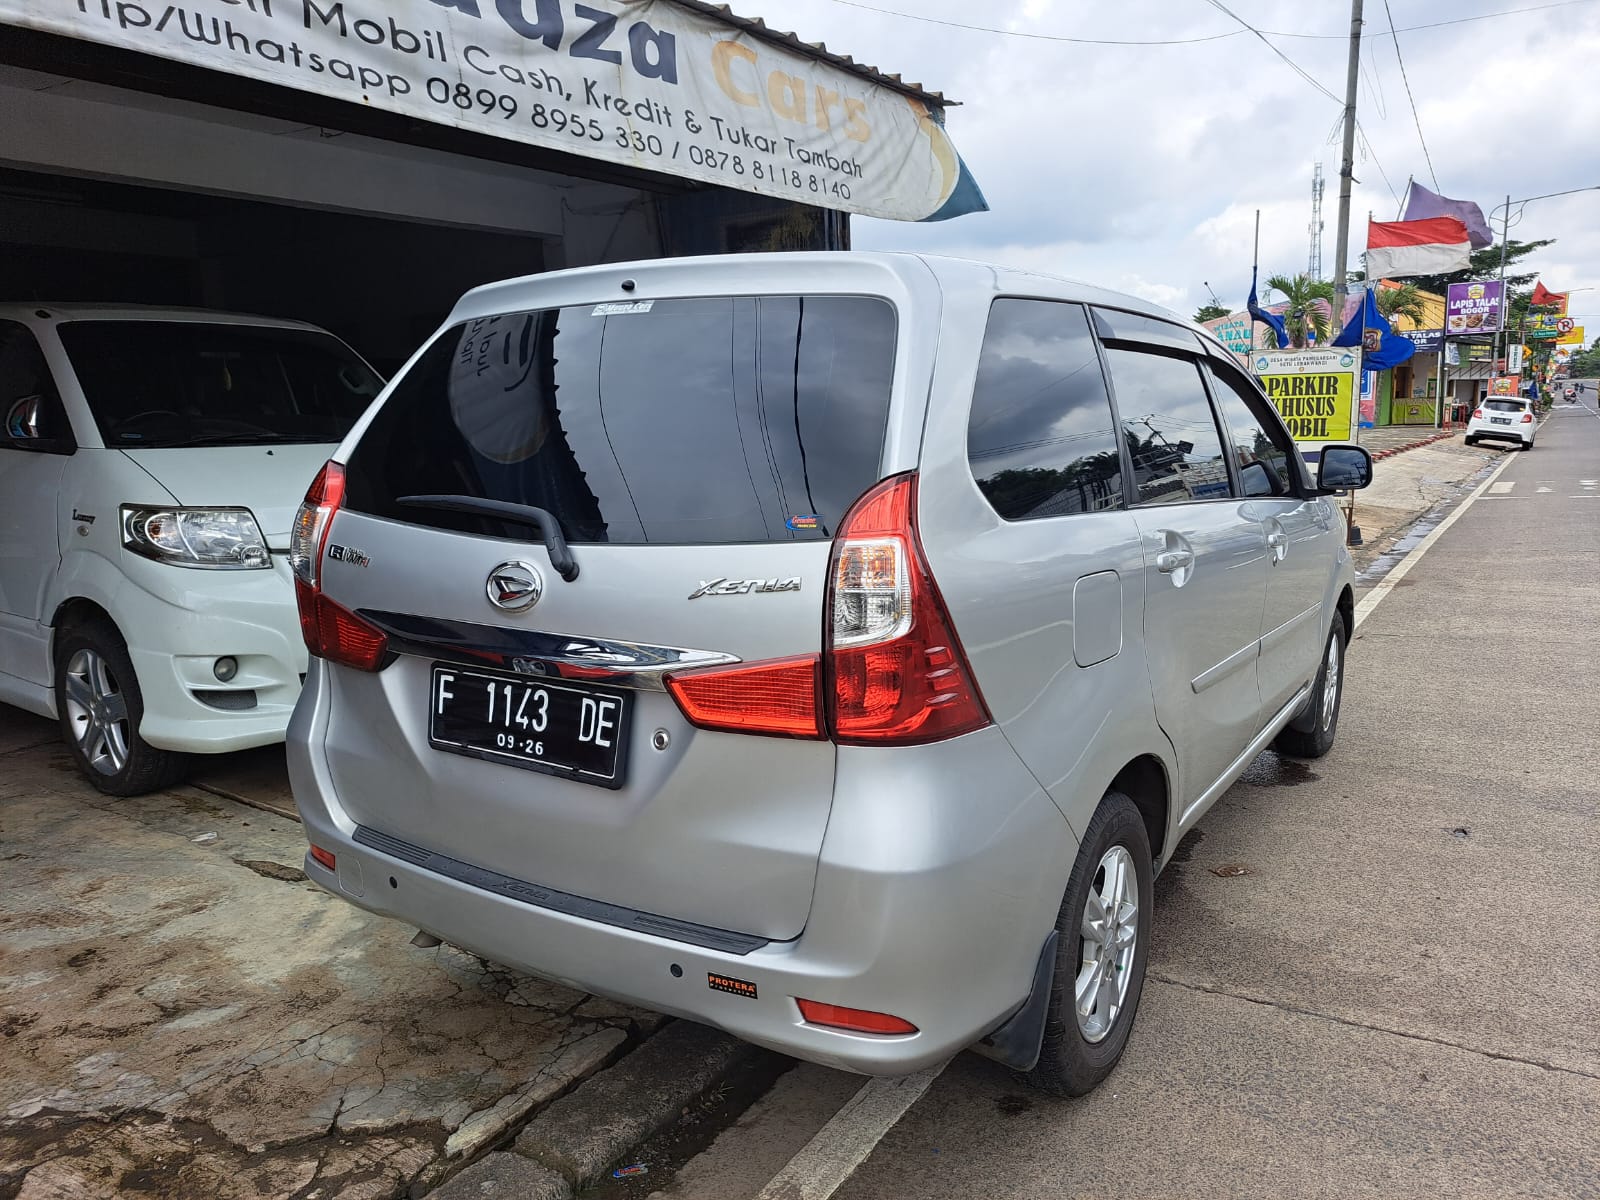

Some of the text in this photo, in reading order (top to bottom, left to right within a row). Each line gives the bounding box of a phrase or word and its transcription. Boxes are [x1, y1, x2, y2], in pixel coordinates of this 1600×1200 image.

[302, 0, 863, 178] Mobil Cash, Kredit & Tukar Tambah
[711, 39, 872, 144] Cars
[426, 77, 518, 120] 0899
[531, 103, 604, 142] 8955
[615, 126, 662, 156] 330
[672, 141, 680, 160] /
[689, 145, 745, 175] 0878
[752, 160, 801, 188] 8118
[808, 174, 851, 200] 8140
[1450, 298, 1474, 310] LAPIS
[1460, 306, 1490, 315] BOGOR
[1268, 376, 1338, 396] PARKIR
[688, 576, 801, 600] XENIA
[438, 674, 616, 748] F 1143 DE
[708, 975, 755, 993] PROTERA
